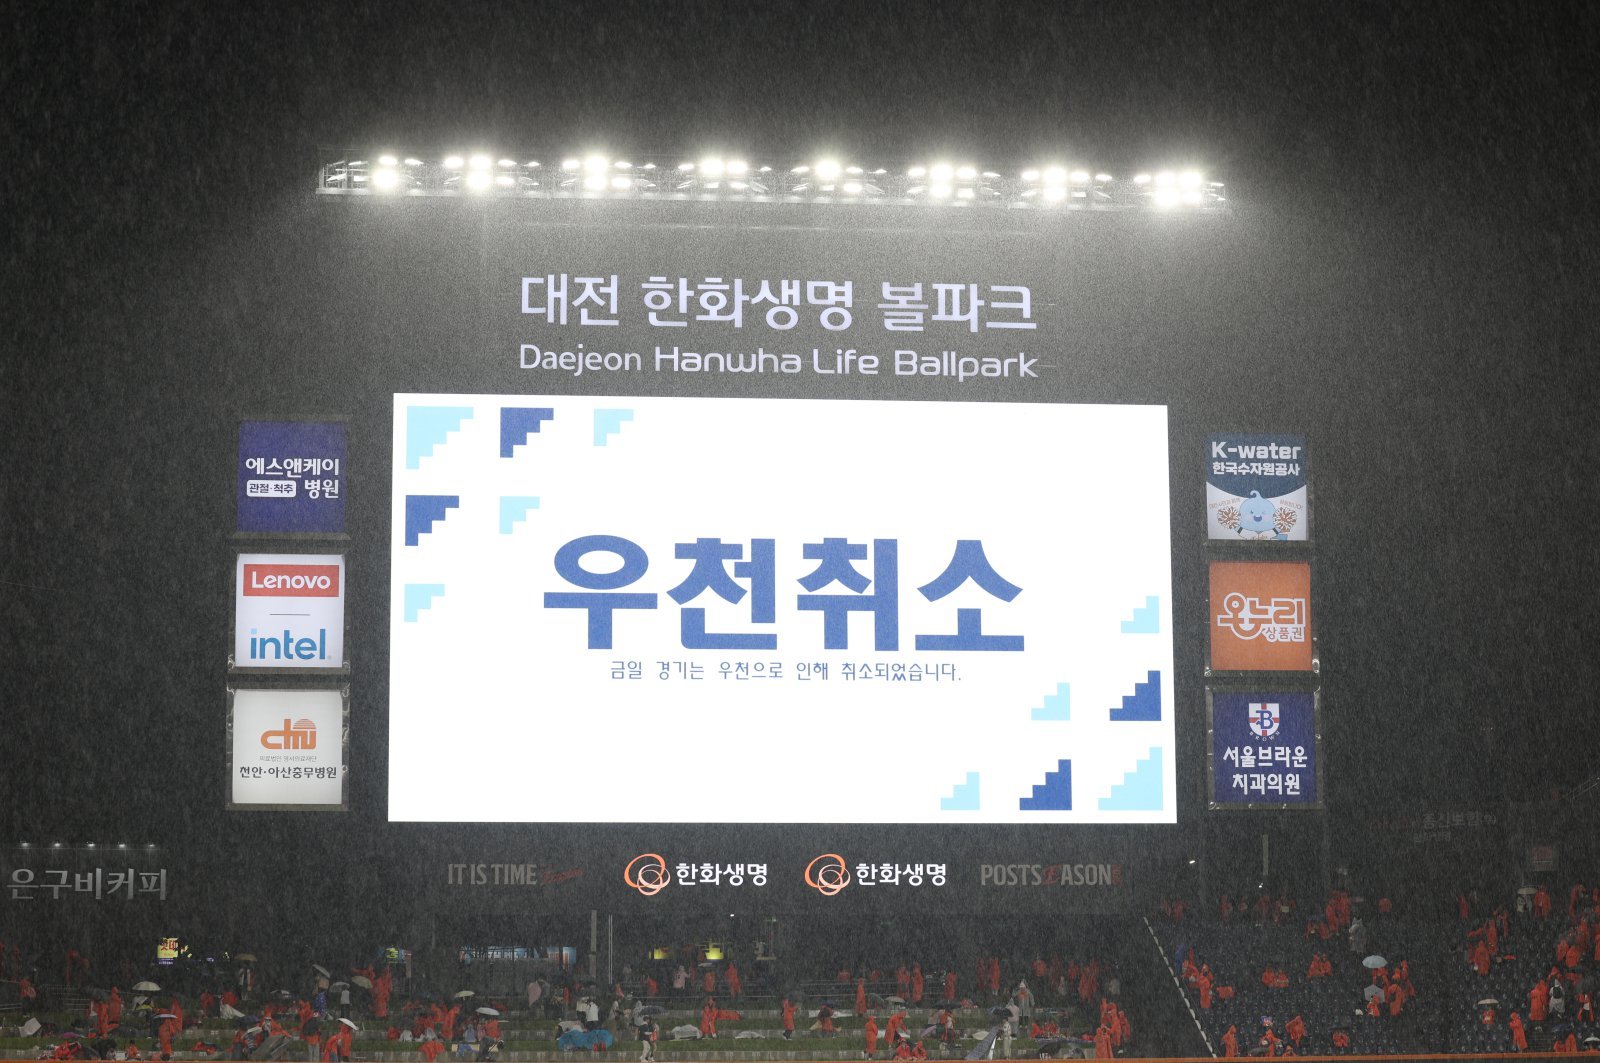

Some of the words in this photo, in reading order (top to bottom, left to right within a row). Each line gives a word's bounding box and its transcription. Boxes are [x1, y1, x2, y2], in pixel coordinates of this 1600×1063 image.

[521, 273, 619, 327] 대전
[641, 276, 853, 331] 한화생명
[877, 281, 1038, 332] 볼파크
[519, 344, 642, 377] Daejeon
[655, 346, 802, 374] Hanwha
[813, 348, 879, 376] Life
[895, 350, 1038, 382] Ballpark
[1211, 441, 1302, 460] K-water
[245, 457, 340, 478] 에스앤케이
[1212, 461, 1301, 476] 한국수자원공사
[304, 479, 339, 499] 병원
[251, 571, 331, 590] Lenovo
[543, 534, 1025, 652] 우천취소
[1265, 626, 1303, 641] 상품권
[610, 660, 643, 681] 금일
[656, 660, 705, 681] 경기는
[717, 661, 784, 681] 우천으로
[796, 661, 829, 682] 인해
[841, 662, 962, 683] 취소되었습니다.
[1222, 745, 1308, 768] 서울브라운
[239, 766, 337, 779] 천안·아산충무병원
[1232, 773, 1300, 795] 치과의원
[7, 867, 167, 900] 은구비커피
[448, 864, 466, 885] IT
[470, 864, 487, 885] IS
[491, 864, 538, 885] TIME
[675, 863, 767, 886] 한화생명
[856, 863, 947, 886] 한화생명
